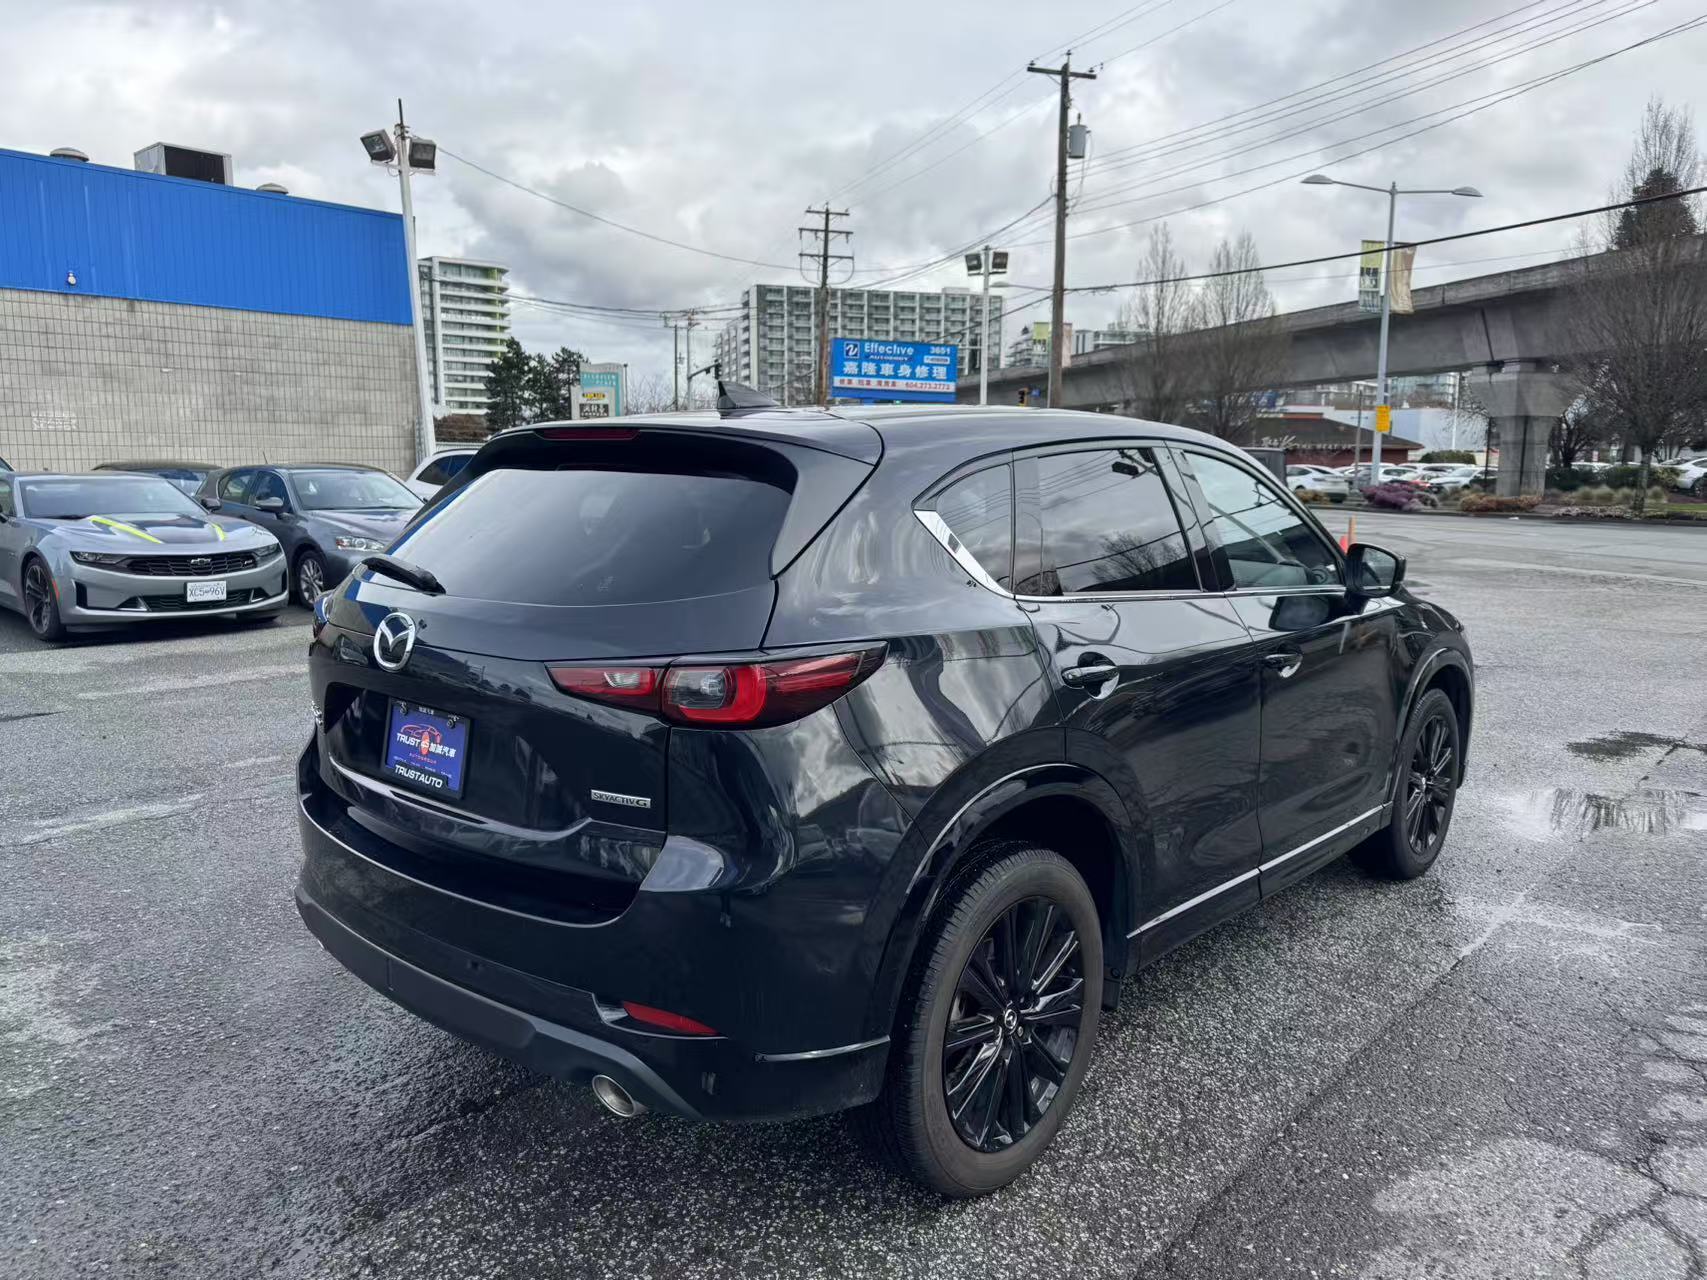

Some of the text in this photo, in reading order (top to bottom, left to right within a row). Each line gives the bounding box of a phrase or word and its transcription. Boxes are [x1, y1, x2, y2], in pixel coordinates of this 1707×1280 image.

[864, 342, 914, 355] Effective
[396, 733, 421, 748] TRUST
[394, 764, 443, 788] TRUSTAUTO
